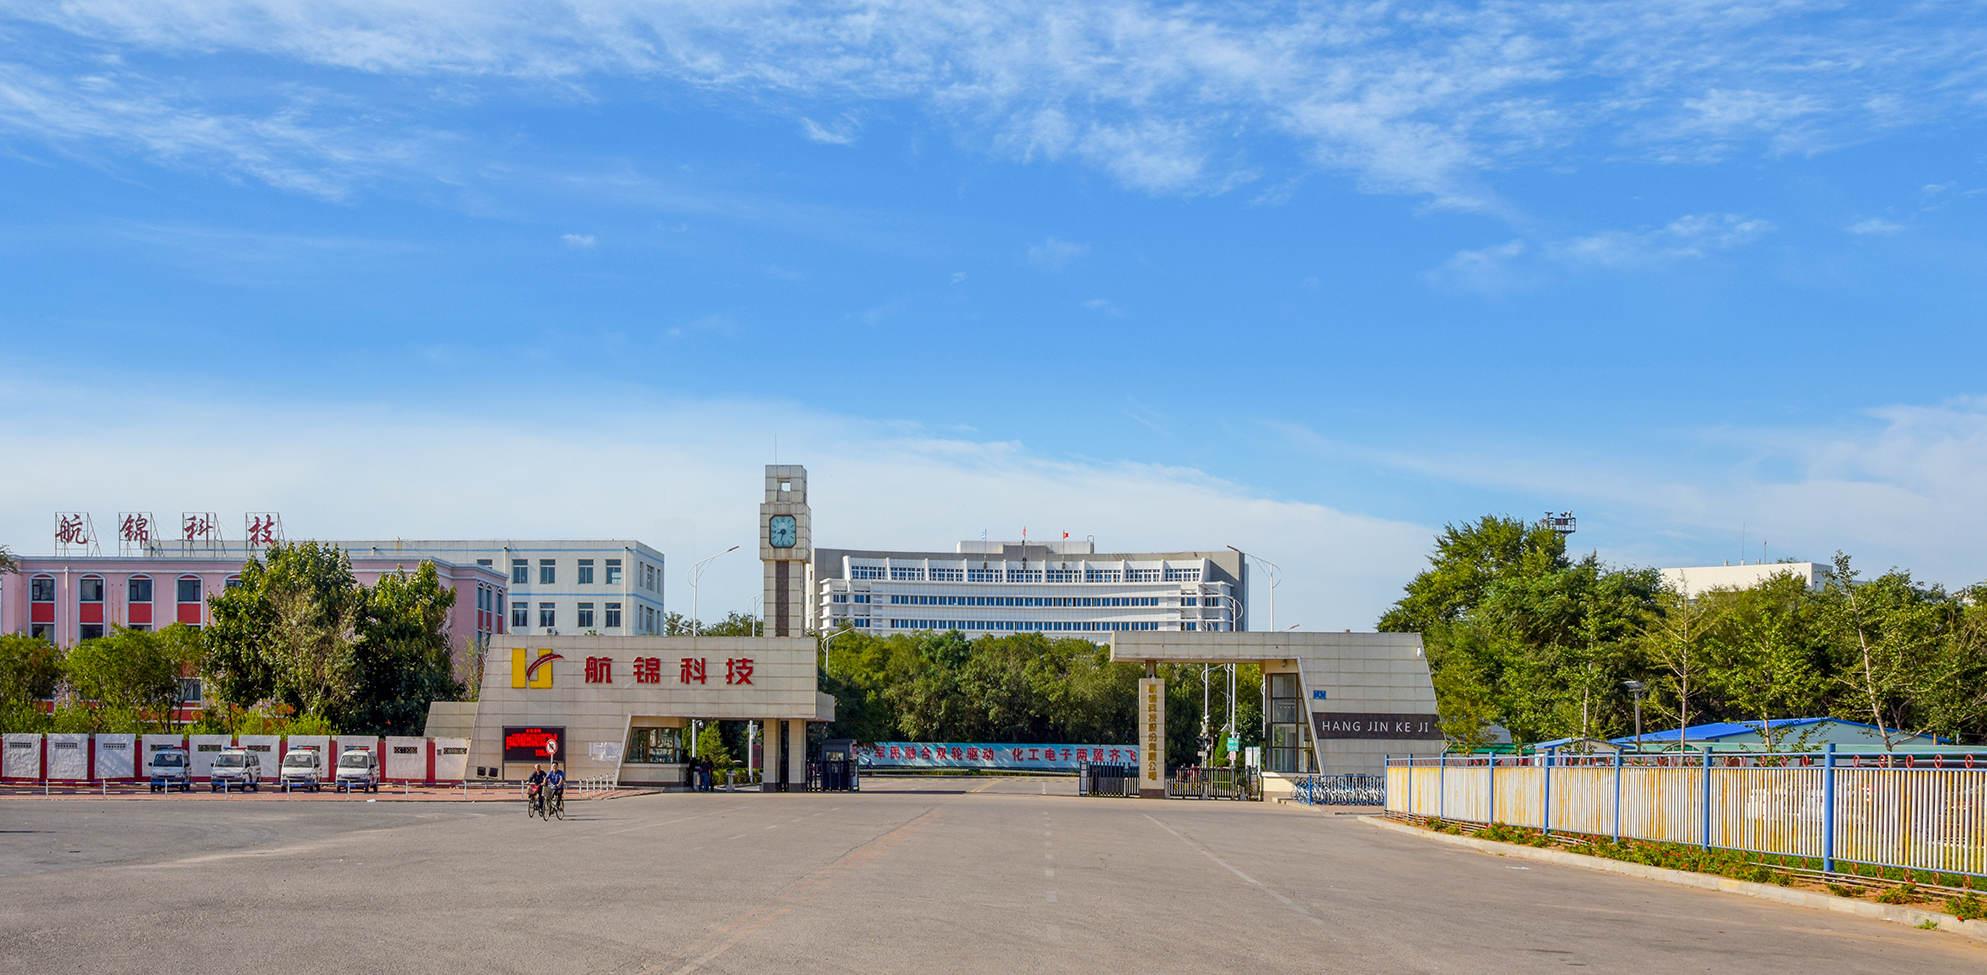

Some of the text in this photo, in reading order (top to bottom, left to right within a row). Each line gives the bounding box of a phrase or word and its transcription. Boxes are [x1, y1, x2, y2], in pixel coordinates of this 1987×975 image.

[55, 512, 276, 549] 航锦科技
[584, 655, 755, 686] 航锦科技
[1321, 720, 1429, 733] HANG JIN KE JI
